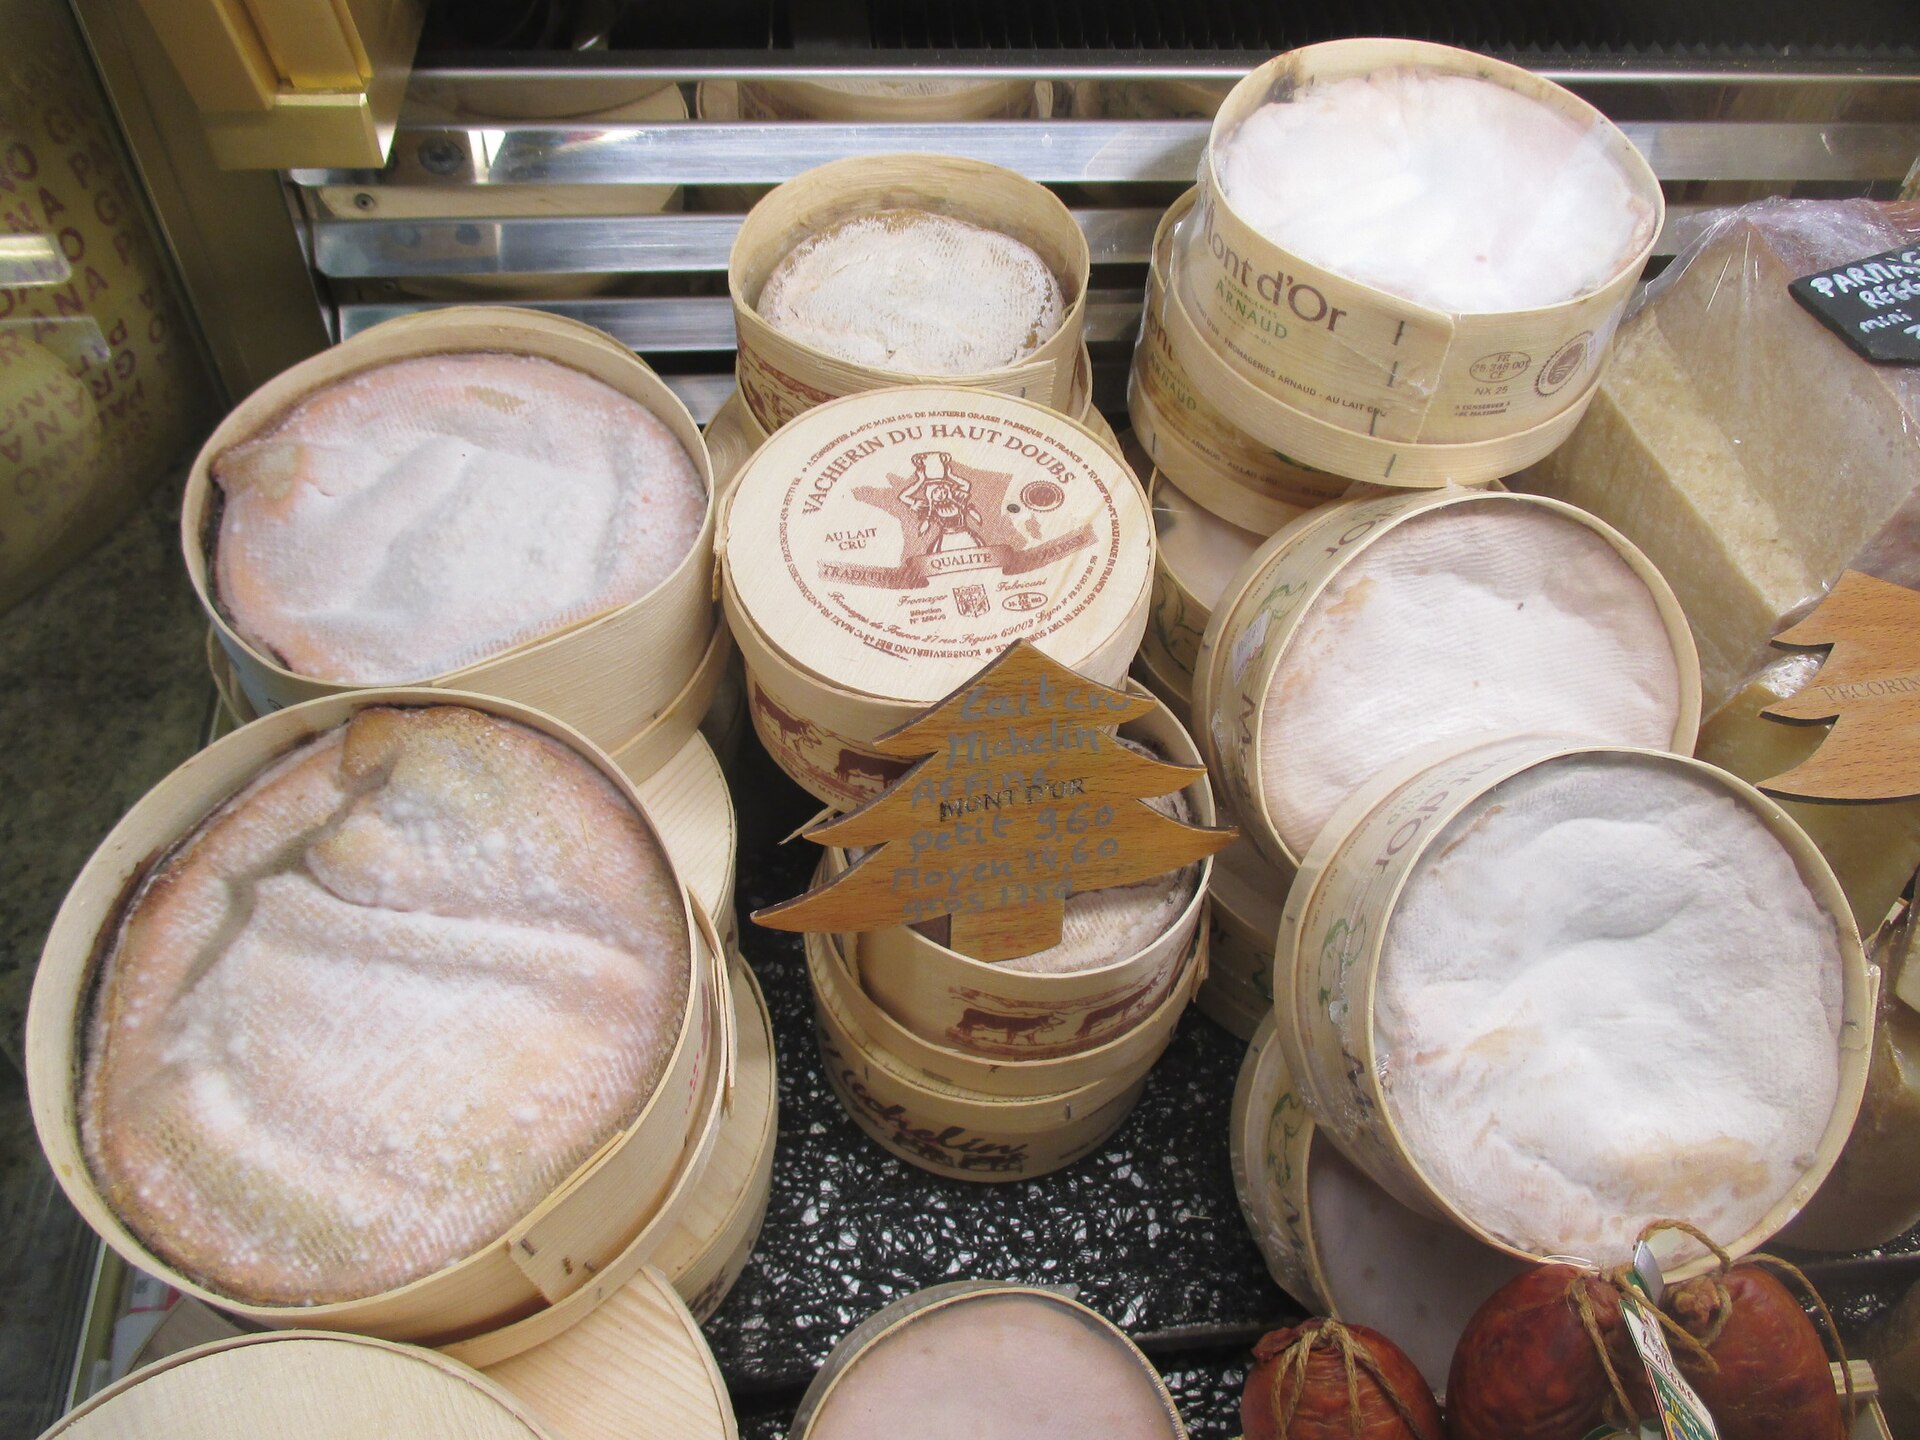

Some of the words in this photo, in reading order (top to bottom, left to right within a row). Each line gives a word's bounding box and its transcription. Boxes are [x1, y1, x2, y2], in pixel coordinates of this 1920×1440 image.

[1215, 278, 1288, 339] ARNAUD
[1257, 271, 1347, 331] d'Or
[1224, 337, 1276, 379] FROMAGERIES
[1277, 374, 1317, 397] ARNAUD
[1325, 395, 1340, 405] AU
[1342, 399, 1364, 411] LAIT
[1474, 387, 1492, 396] NX
[1043, 434, 1058, 445] EN
[1053, 440, 1085, 463] FRANCE
[802, 435, 885, 515] VACHERIN
[886, 425, 923, 445] DU
[930, 423, 1003, 444] HAUT
[1002, 435, 1077, 484] DOUBS
[824, 531, 844, 543] AU
[847, 527, 878, 539] LAIT
[838, 540, 868, 551] CRU
[1107, 538, 1120, 558] MADE
[930, 553, 992, 571] QUALITE
[995, 577, 1048, 592] Fabricant
[1090, 566, 1114, 593] FRANCE
[827, 615, 855, 634] MAXI
[1044, 619, 1066, 633] DRY
[1060, 613, 1075, 623] IN
[944, 717, 1101, 770] Michelin
[939, 788, 1016, 822] MONT
[1025, 777, 1087, 805] D'OR
[908, 812, 1014, 866] petit
